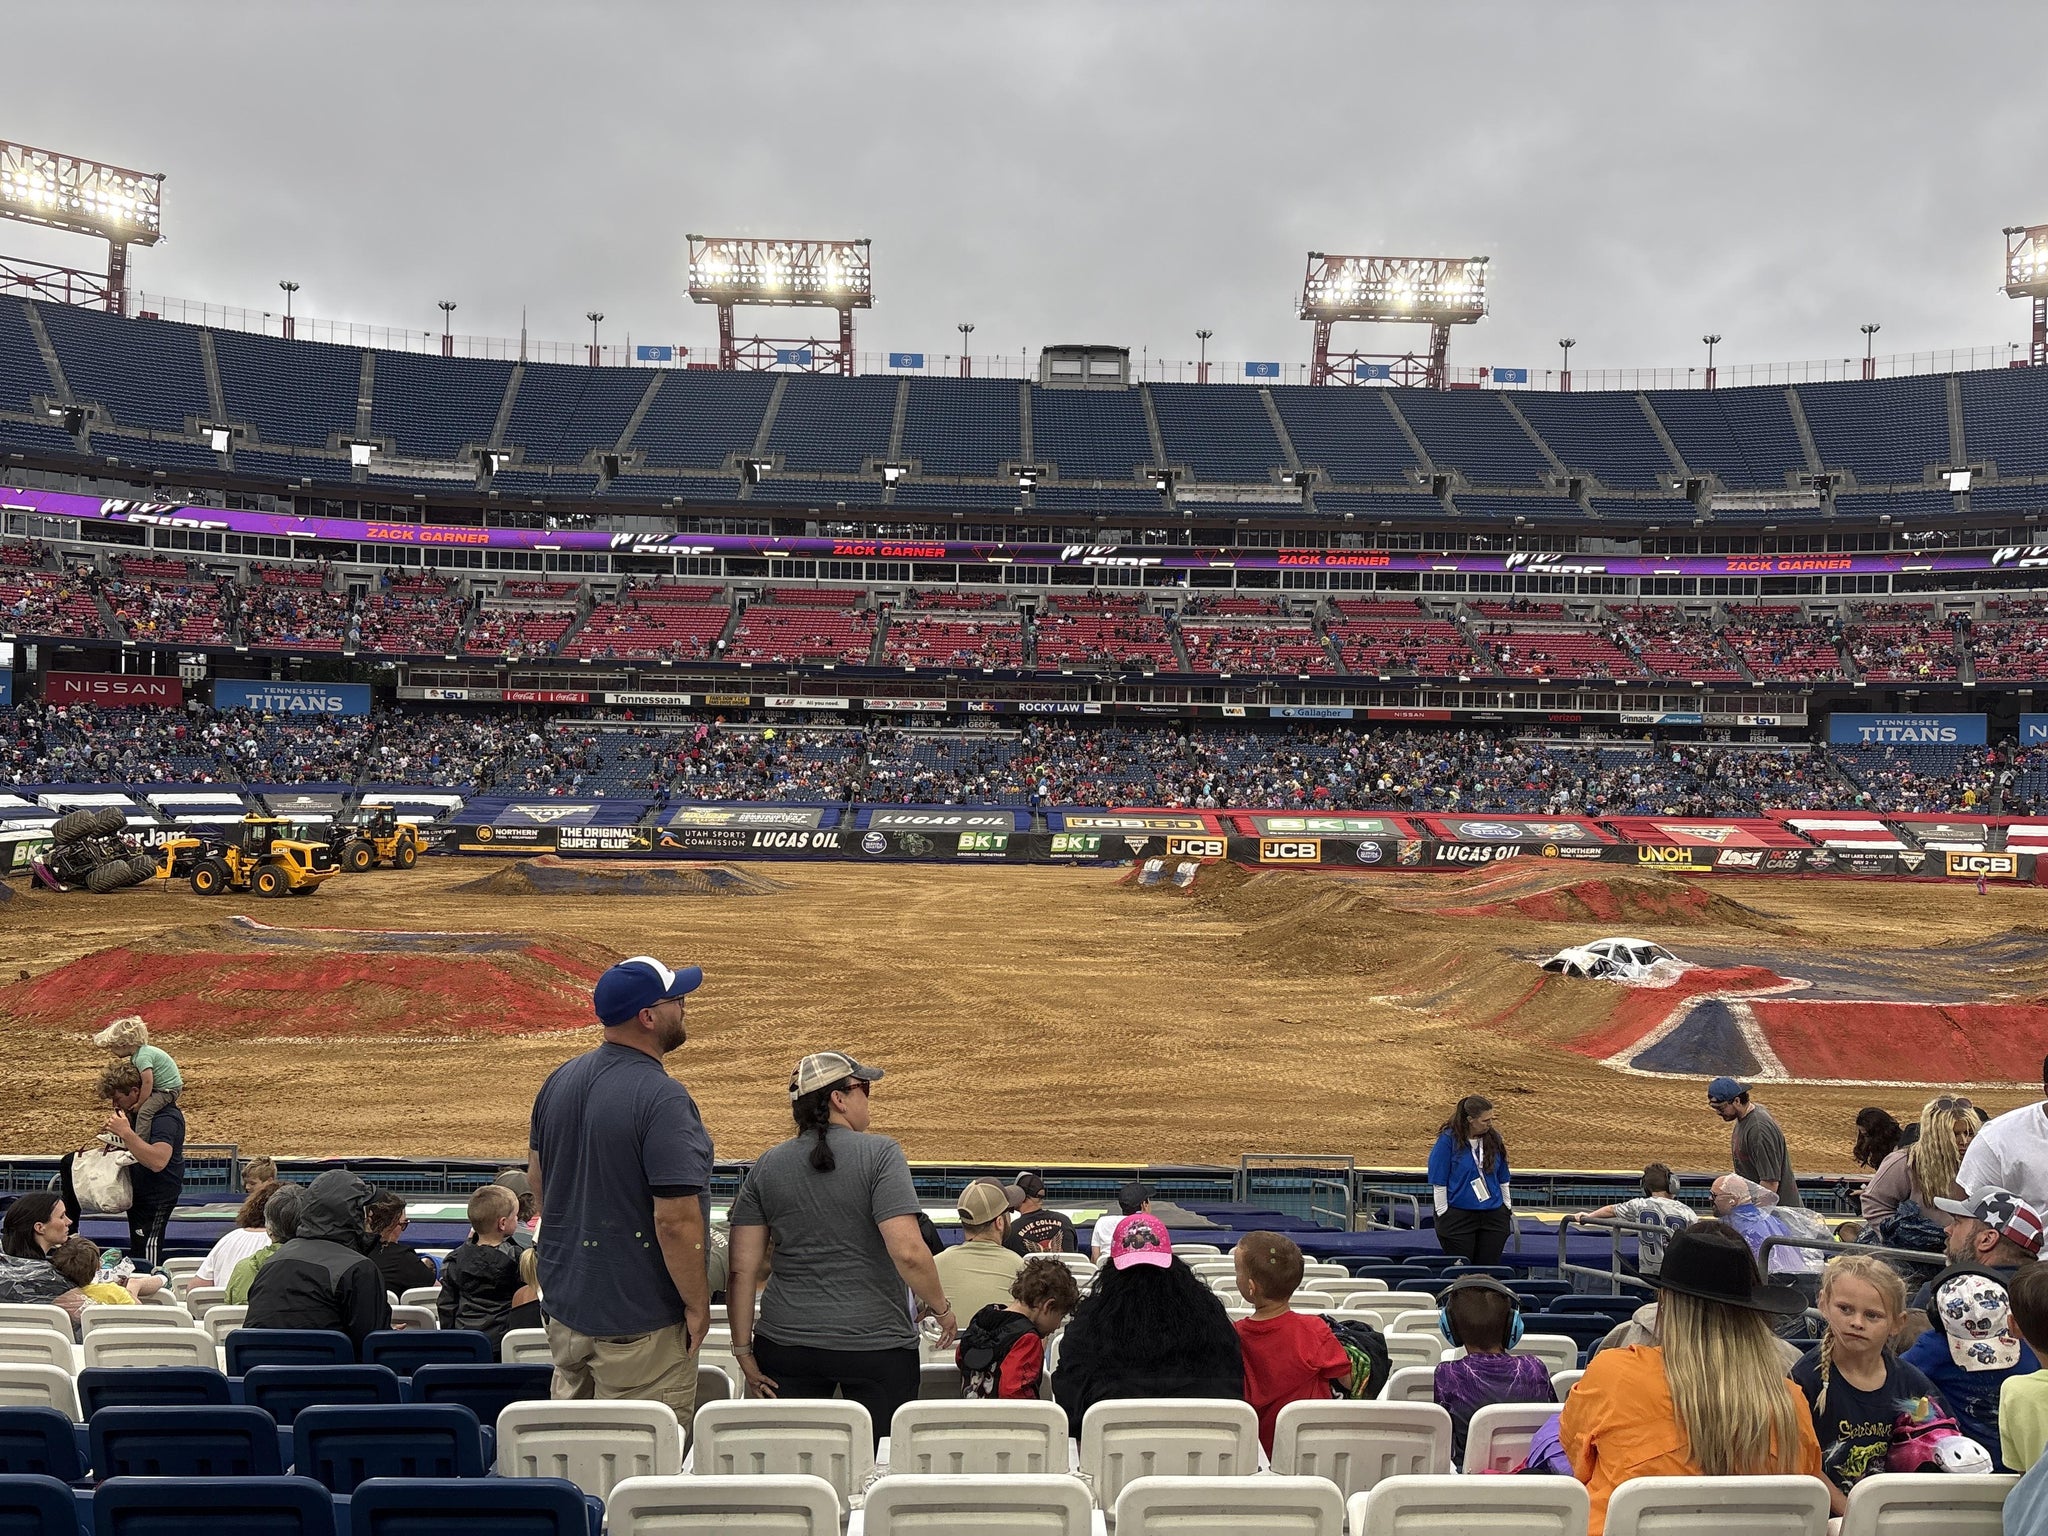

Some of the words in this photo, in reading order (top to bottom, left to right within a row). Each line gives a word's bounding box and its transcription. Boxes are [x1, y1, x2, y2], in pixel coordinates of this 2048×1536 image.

[366, 528, 413, 541] ZACK
[419, 531, 490, 544] GARNER
[833, 546, 875, 556] ZACK
[881, 546, 946, 558] GARNER
[1277, 556, 1320, 566] ZACK
[1325, 556, 1390, 566] GARNER
[1726, 561, 1773, 571] ZACK
[1778, 559, 1852, 571] GARNER
[65, 680, 167, 695] NISSAN
[263, 687, 326, 695] TENNESSEE
[245, 694, 344, 712] TITANS
[1019, 703, 1055, 712] ROCKY
[1057, 704, 1080, 712] LAW
[911, 713, 936, 721] STEVE
[1297, 709, 1342, 718] Gallagher
[1548, 714, 1582, 722] verizon
[1621, 714, 1654, 723] Pinnacle
[1750, 735, 1779, 743] FISHER
[1858, 727, 1957, 742] TITANS
[878, 815, 962, 824] LUCAS
[1270, 820, 1378, 829] BKT
[560, 827, 582, 837] THE
[584, 827, 635, 838] ORIGINAL
[560, 838, 598, 848] SUPER
[601, 839, 630, 849] GLUE
[752, 832, 809, 848] LUCAS
[959, 835, 1007, 848] BKT
[1052, 837, 1099, 849] BKT
[1171, 841, 1222, 855] JCB
[1265, 843, 1316, 858] JCB
[1436, 845, 1491, 861] LUCAS
[1638, 846, 1692, 862] UNOH
[1769, 850, 1785, 859] RC
[1766, 859, 1797, 869] CARS
[1952, 857, 2012, 871] JCB
[1018, 1222, 1035, 1237] BLUE
[1035, 1219, 1062, 1227] COLLAR
